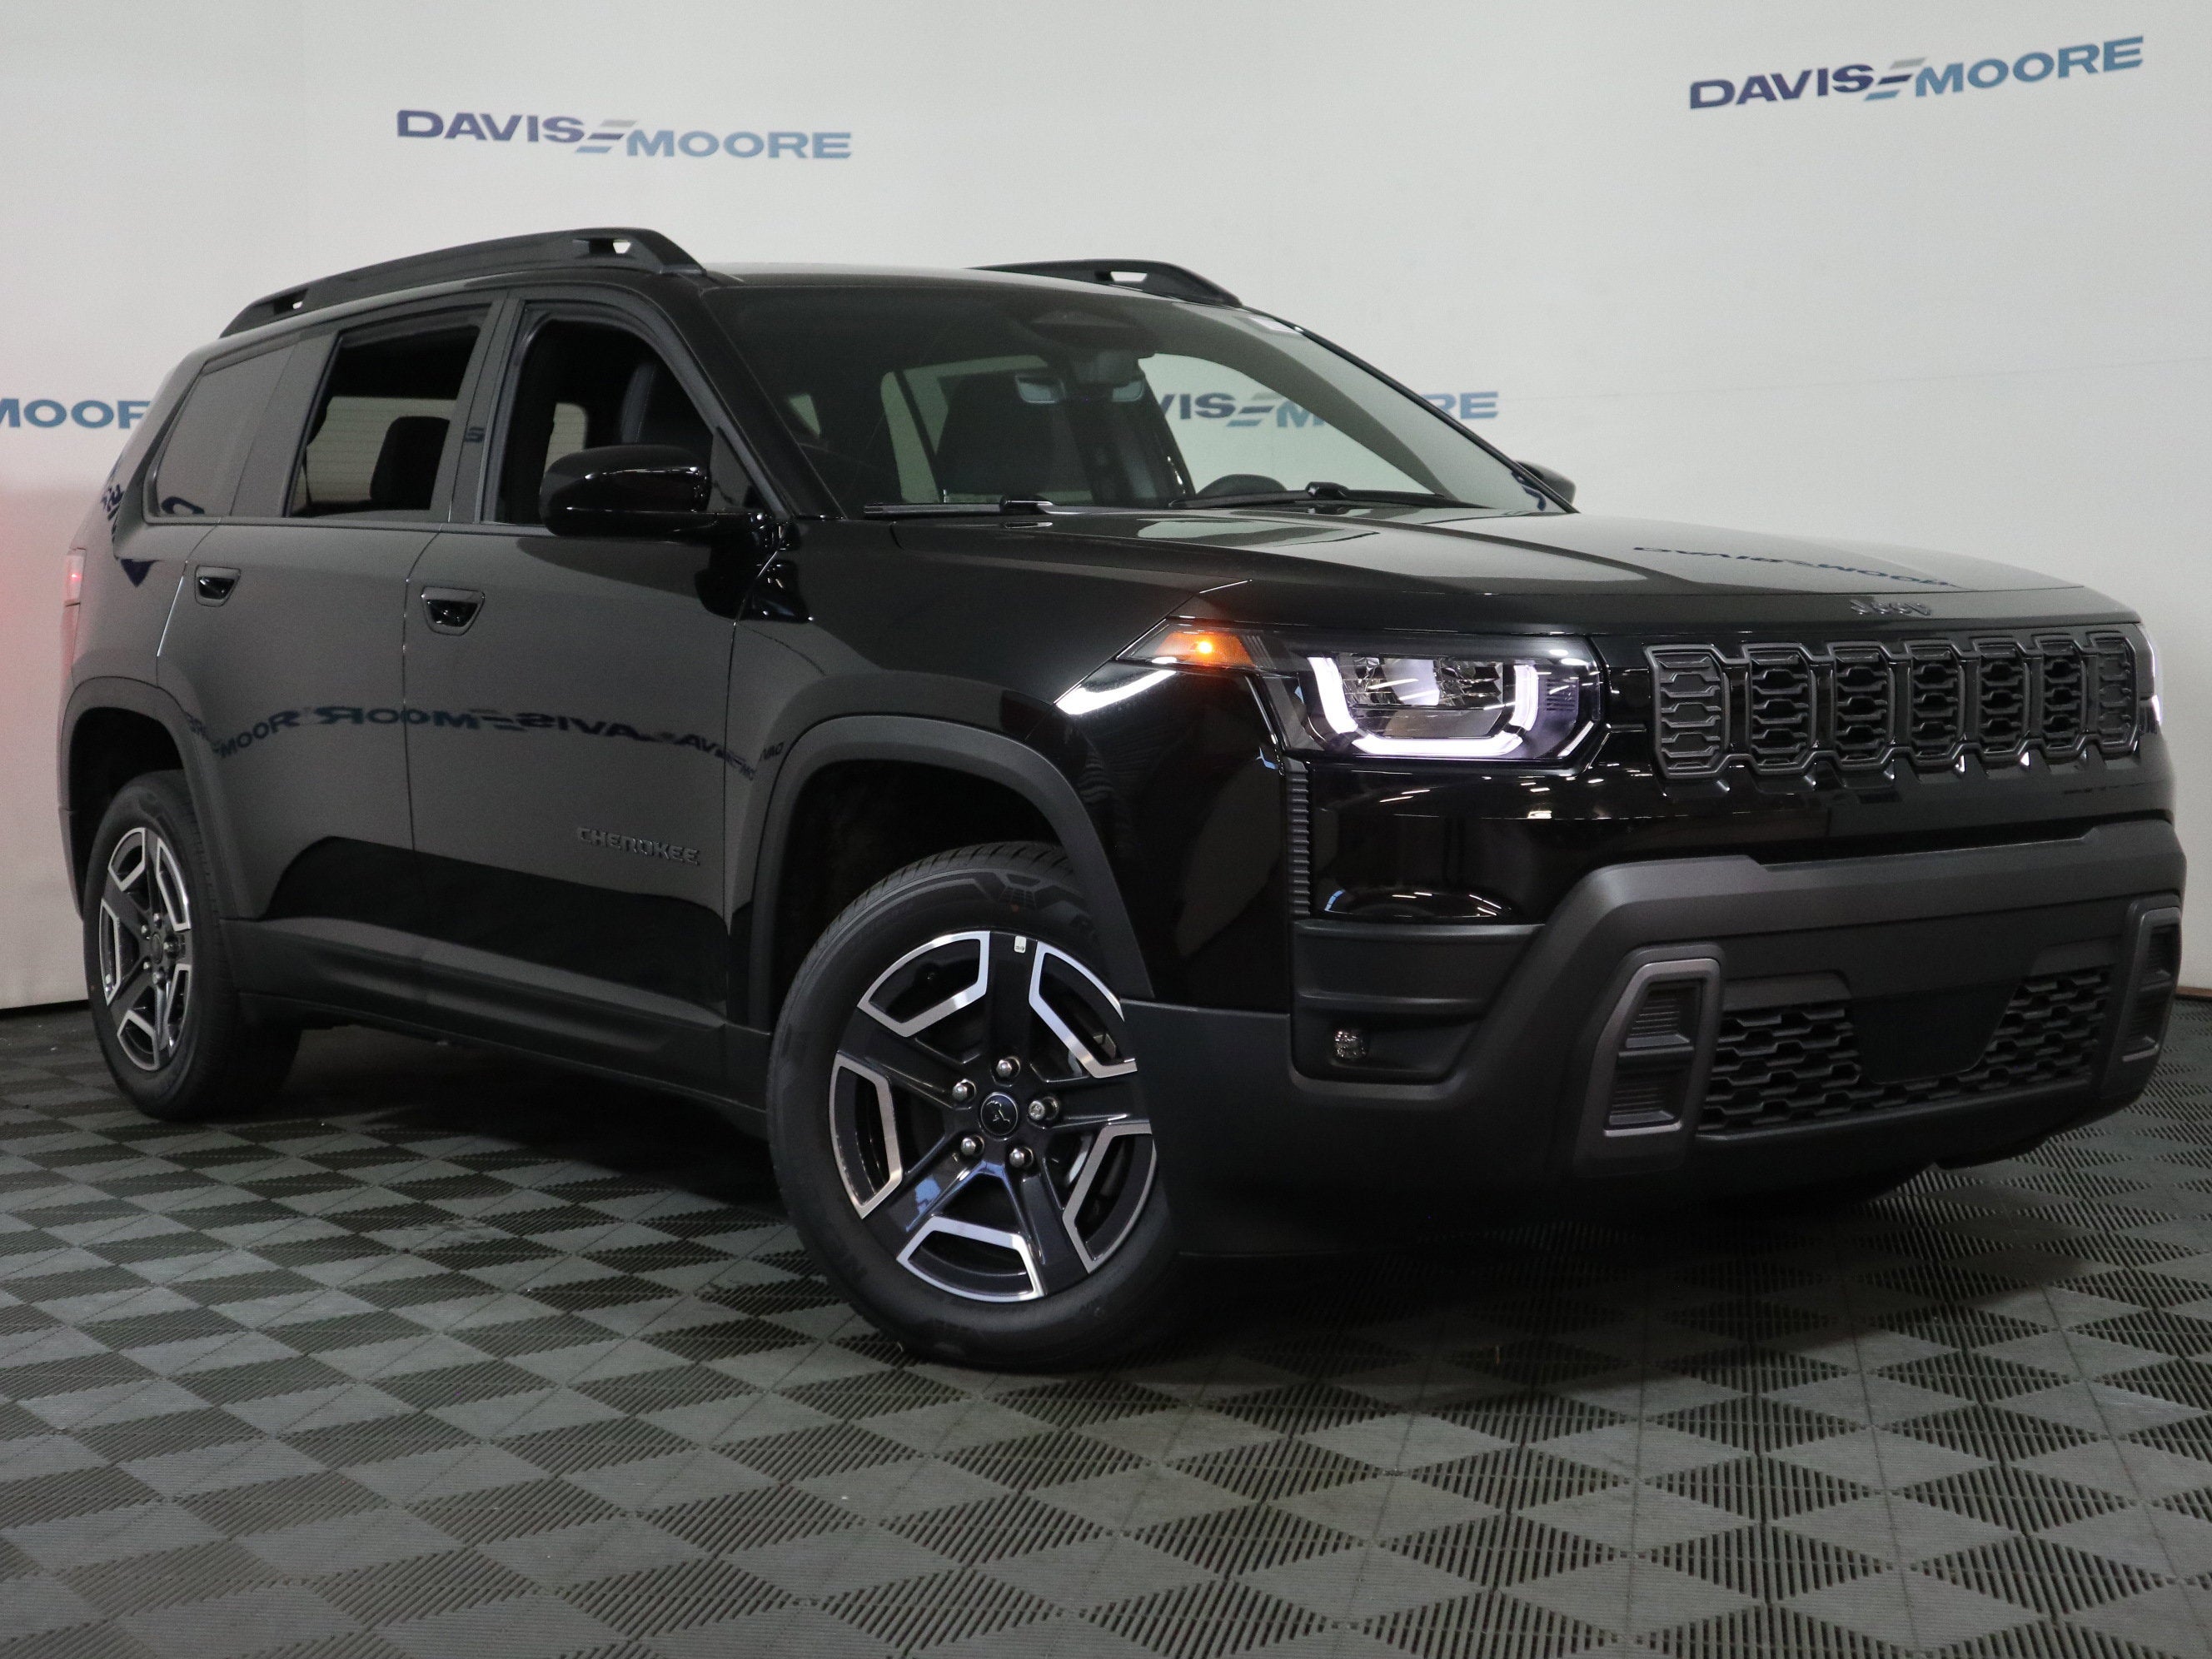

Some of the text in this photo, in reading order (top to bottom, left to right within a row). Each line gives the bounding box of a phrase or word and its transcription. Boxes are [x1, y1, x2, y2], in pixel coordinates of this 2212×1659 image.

[1690, 36, 2144, 109] DAVIS MOORE
[396, 109, 851, 159] DAVIS MOORE
[0, 398, 151, 429] OOR
[576, 826, 700, 866] CHEROKEE
